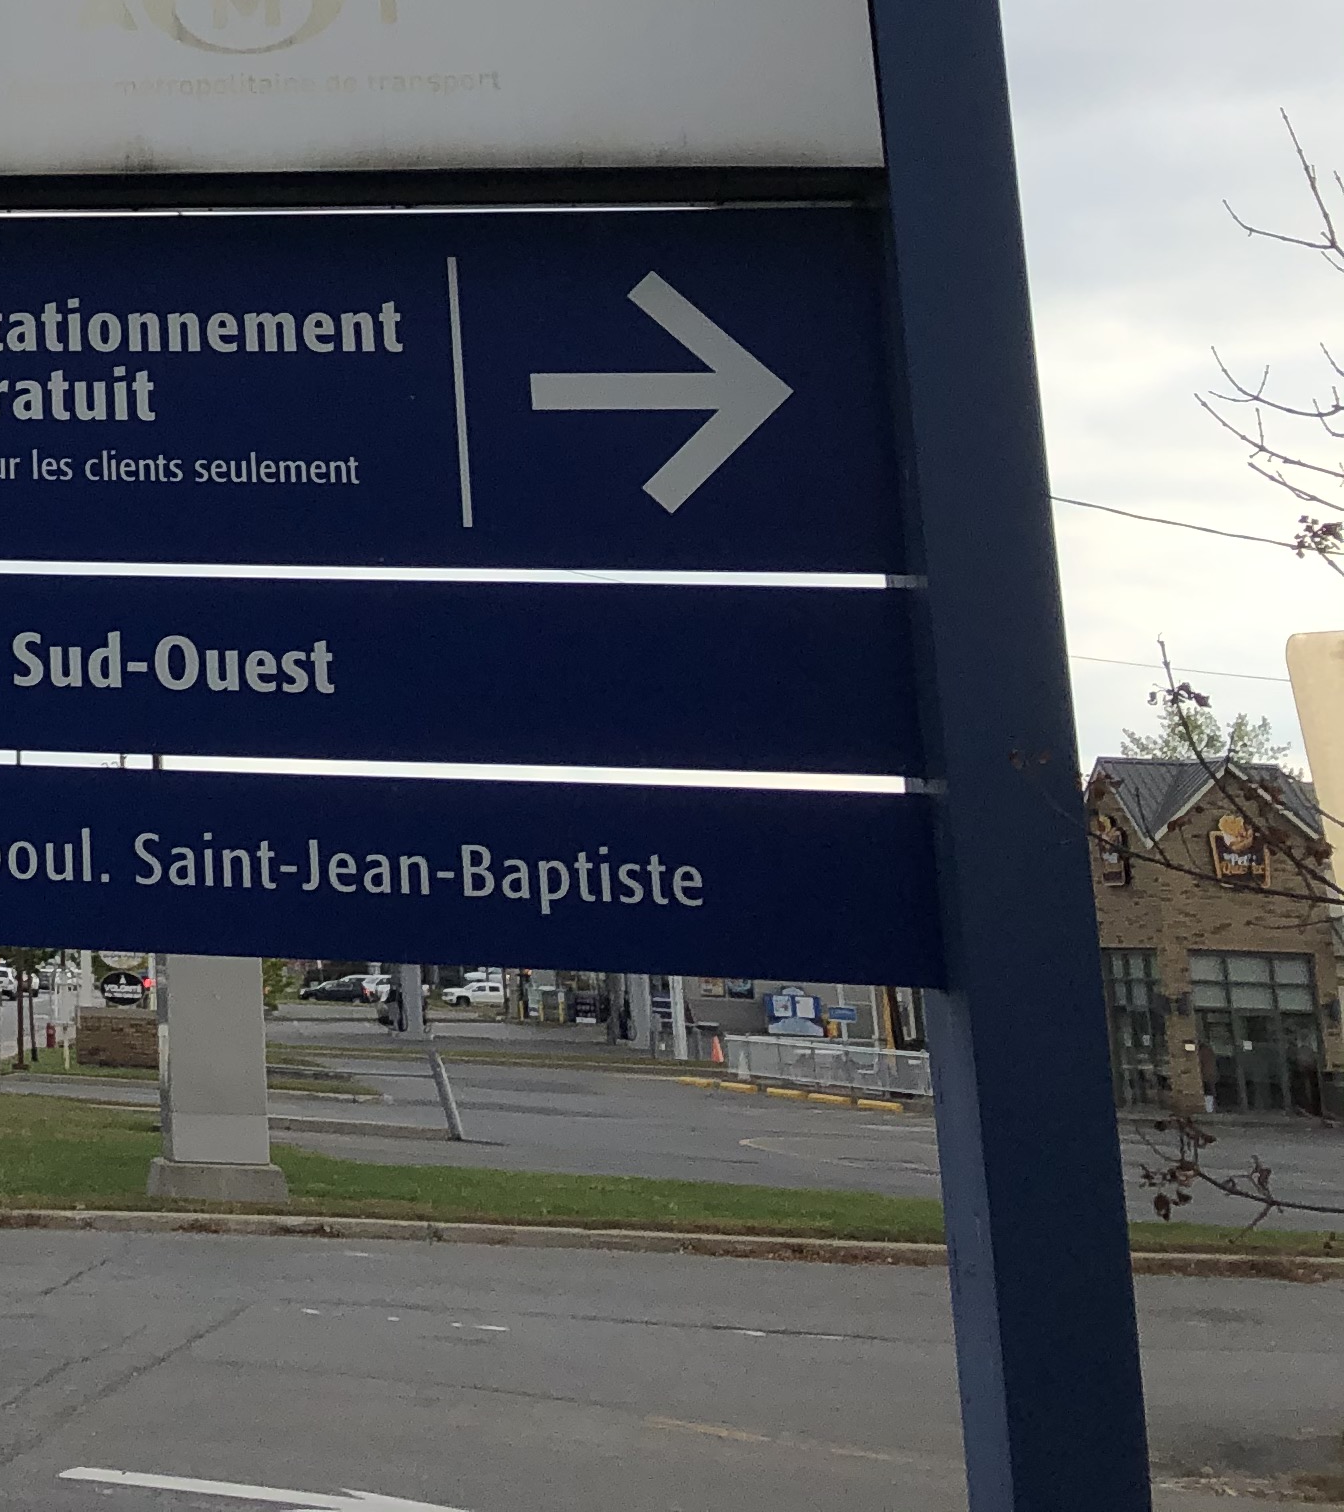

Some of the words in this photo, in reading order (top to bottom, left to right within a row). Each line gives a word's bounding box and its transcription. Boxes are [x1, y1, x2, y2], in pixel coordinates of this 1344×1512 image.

[31, 448, 73, 481] les
[84, 449, 184, 482] clients
[194, 451, 360, 485] seulement
[12, 630, 335, 694] Sud-Ouest
[134, 832, 703, 915] Saint-Jean-Baptiste
